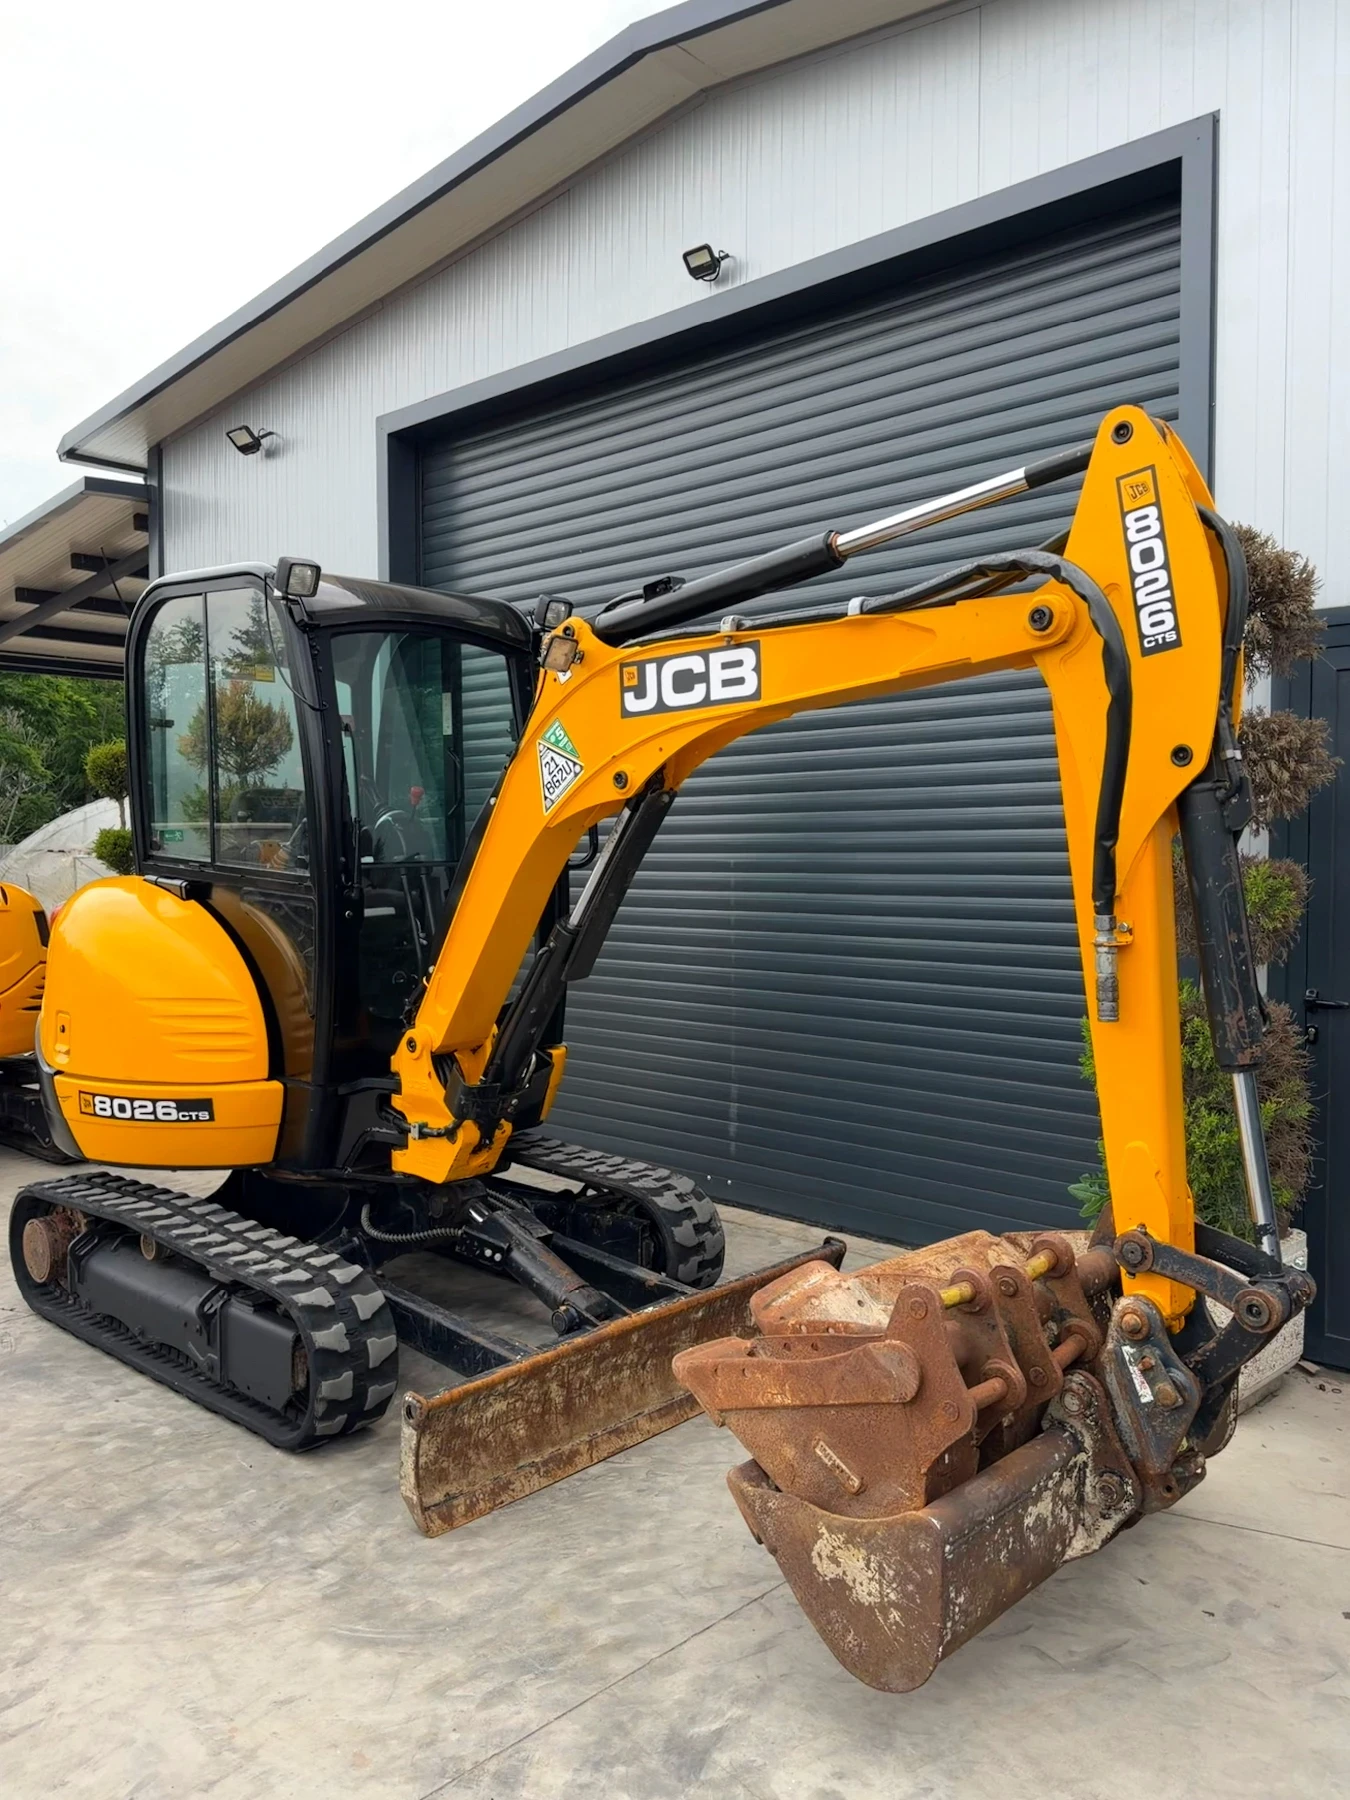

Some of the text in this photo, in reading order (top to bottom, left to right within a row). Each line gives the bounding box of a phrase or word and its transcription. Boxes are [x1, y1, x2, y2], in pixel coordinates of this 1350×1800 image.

[1130, 481, 1149, 500] JCB
[1125, 505, 1175, 636] 8026
[1143, 630, 1177, 648] CTS
[624, 647, 758, 712] JCB
[544, 755, 559, 777] 21
[93, 1095, 178, 1121] 8026
[178, 1111, 210, 1121] CTS
